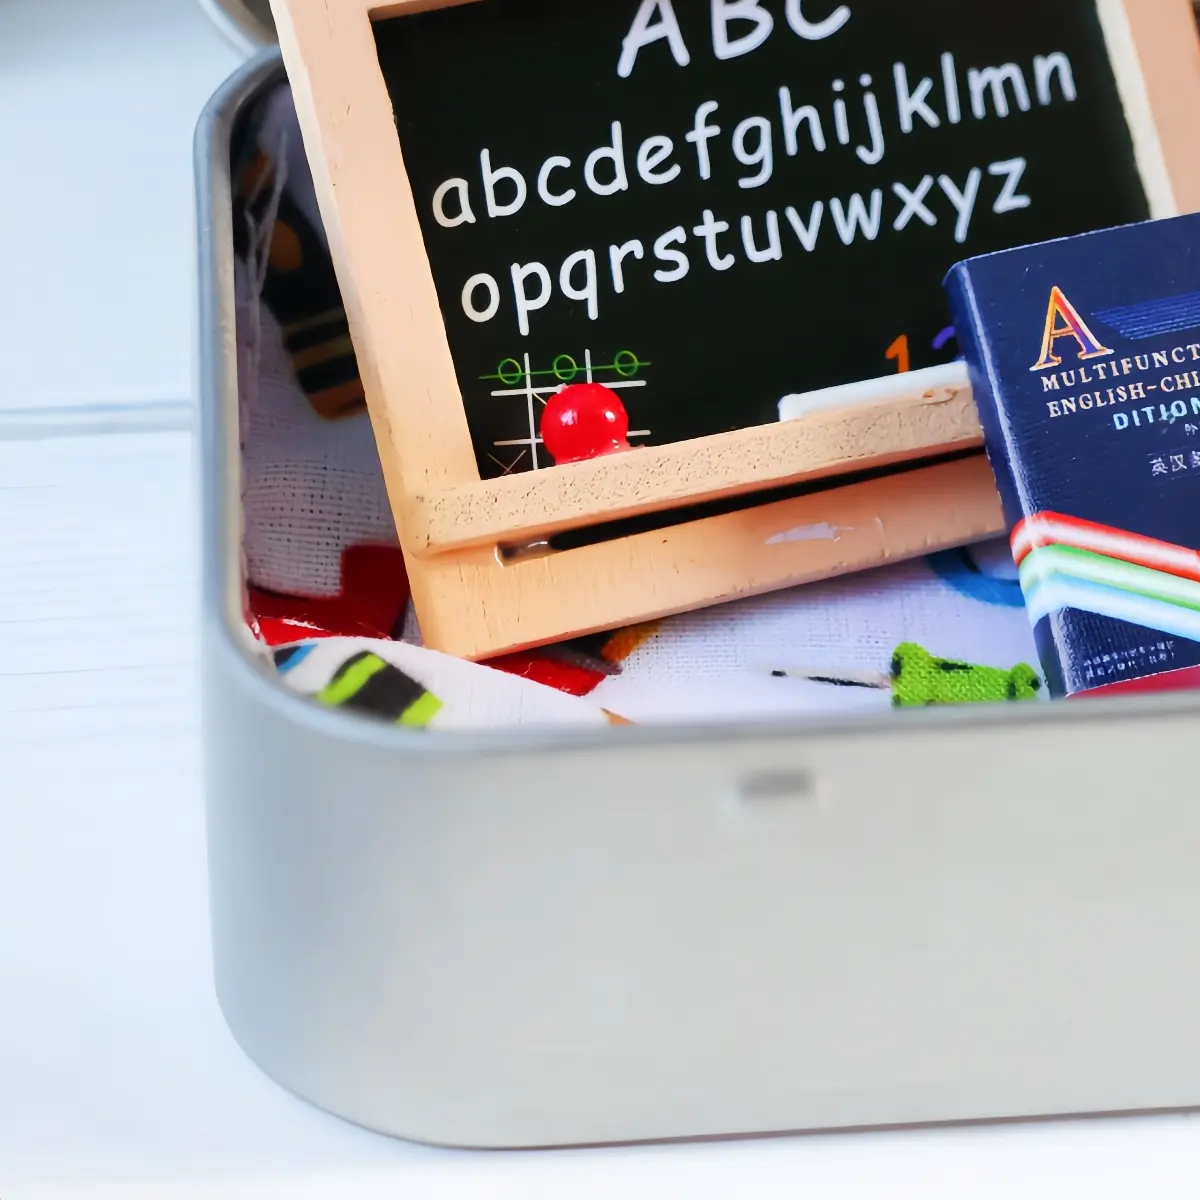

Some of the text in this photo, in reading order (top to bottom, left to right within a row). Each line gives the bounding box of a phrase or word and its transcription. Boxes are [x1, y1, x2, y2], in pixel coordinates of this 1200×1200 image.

[432, 52, 1077, 228] abcdefghijklmn
[461, 157, 1032, 335] opqrstuvwxyz
[1029, 285, 1115, 371] A
